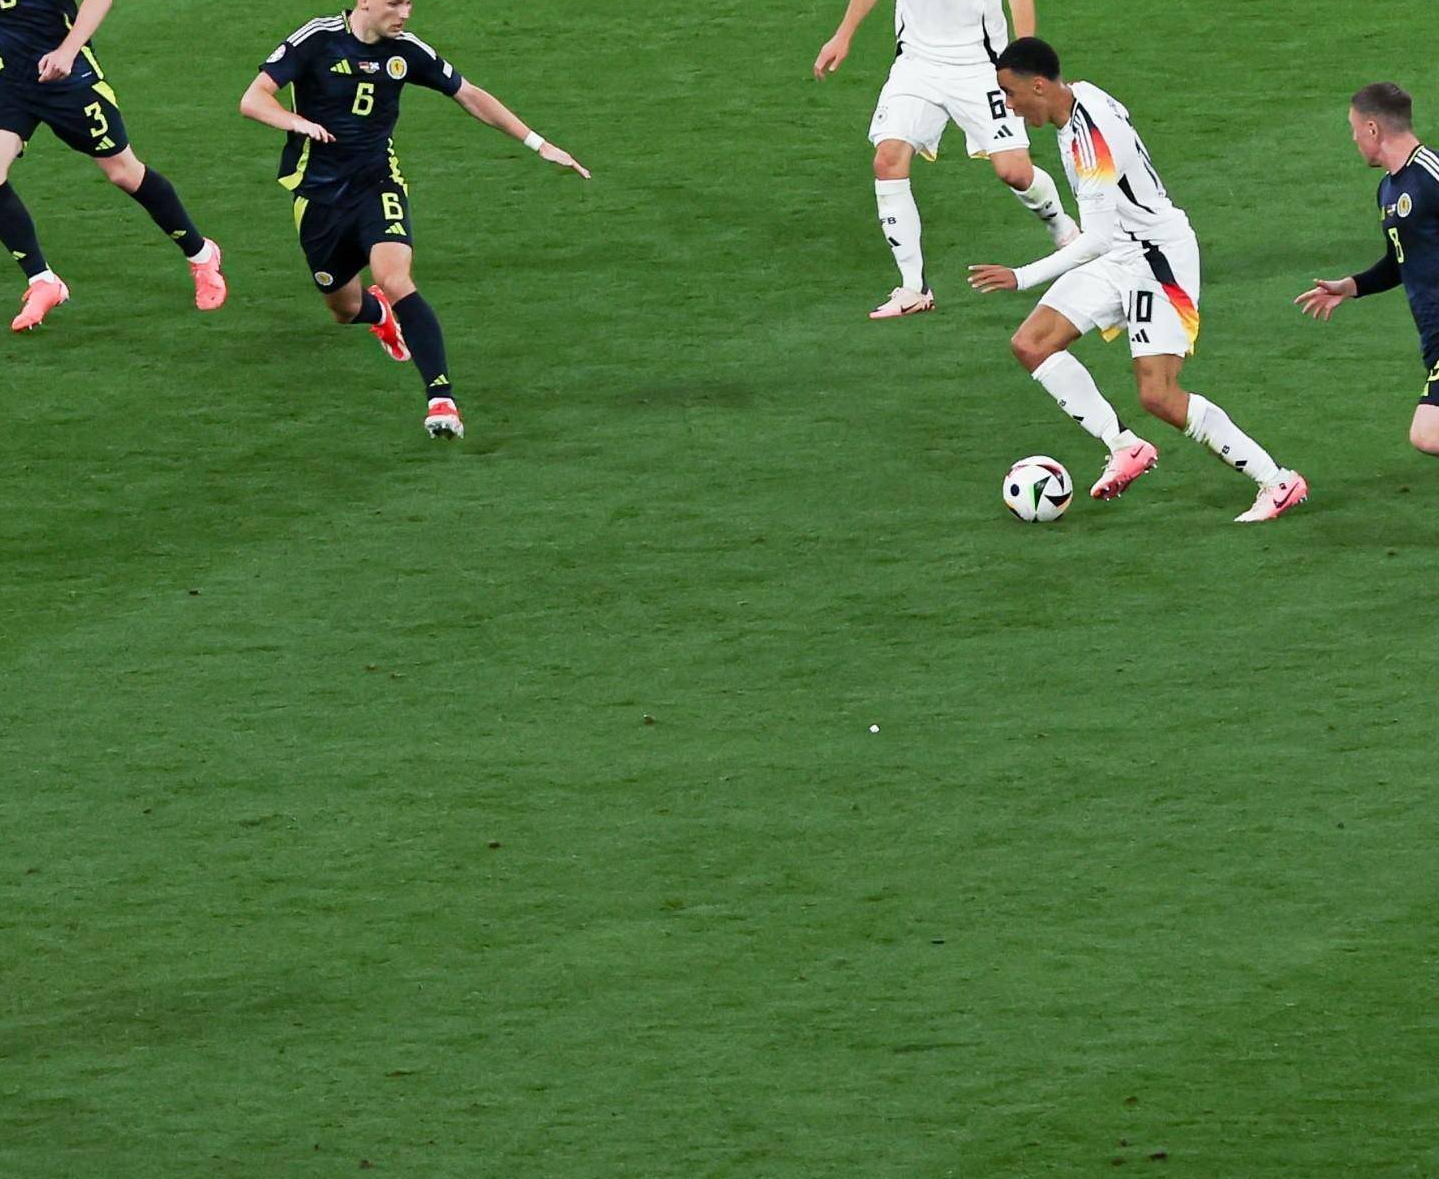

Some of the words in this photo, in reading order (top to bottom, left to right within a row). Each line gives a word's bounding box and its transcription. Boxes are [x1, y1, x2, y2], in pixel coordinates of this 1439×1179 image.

[351, 82, 376, 117] 6
[986, 90, 1007, 120] 6
[83, 101, 109, 138] 3
[381, 192, 405, 221] 6
